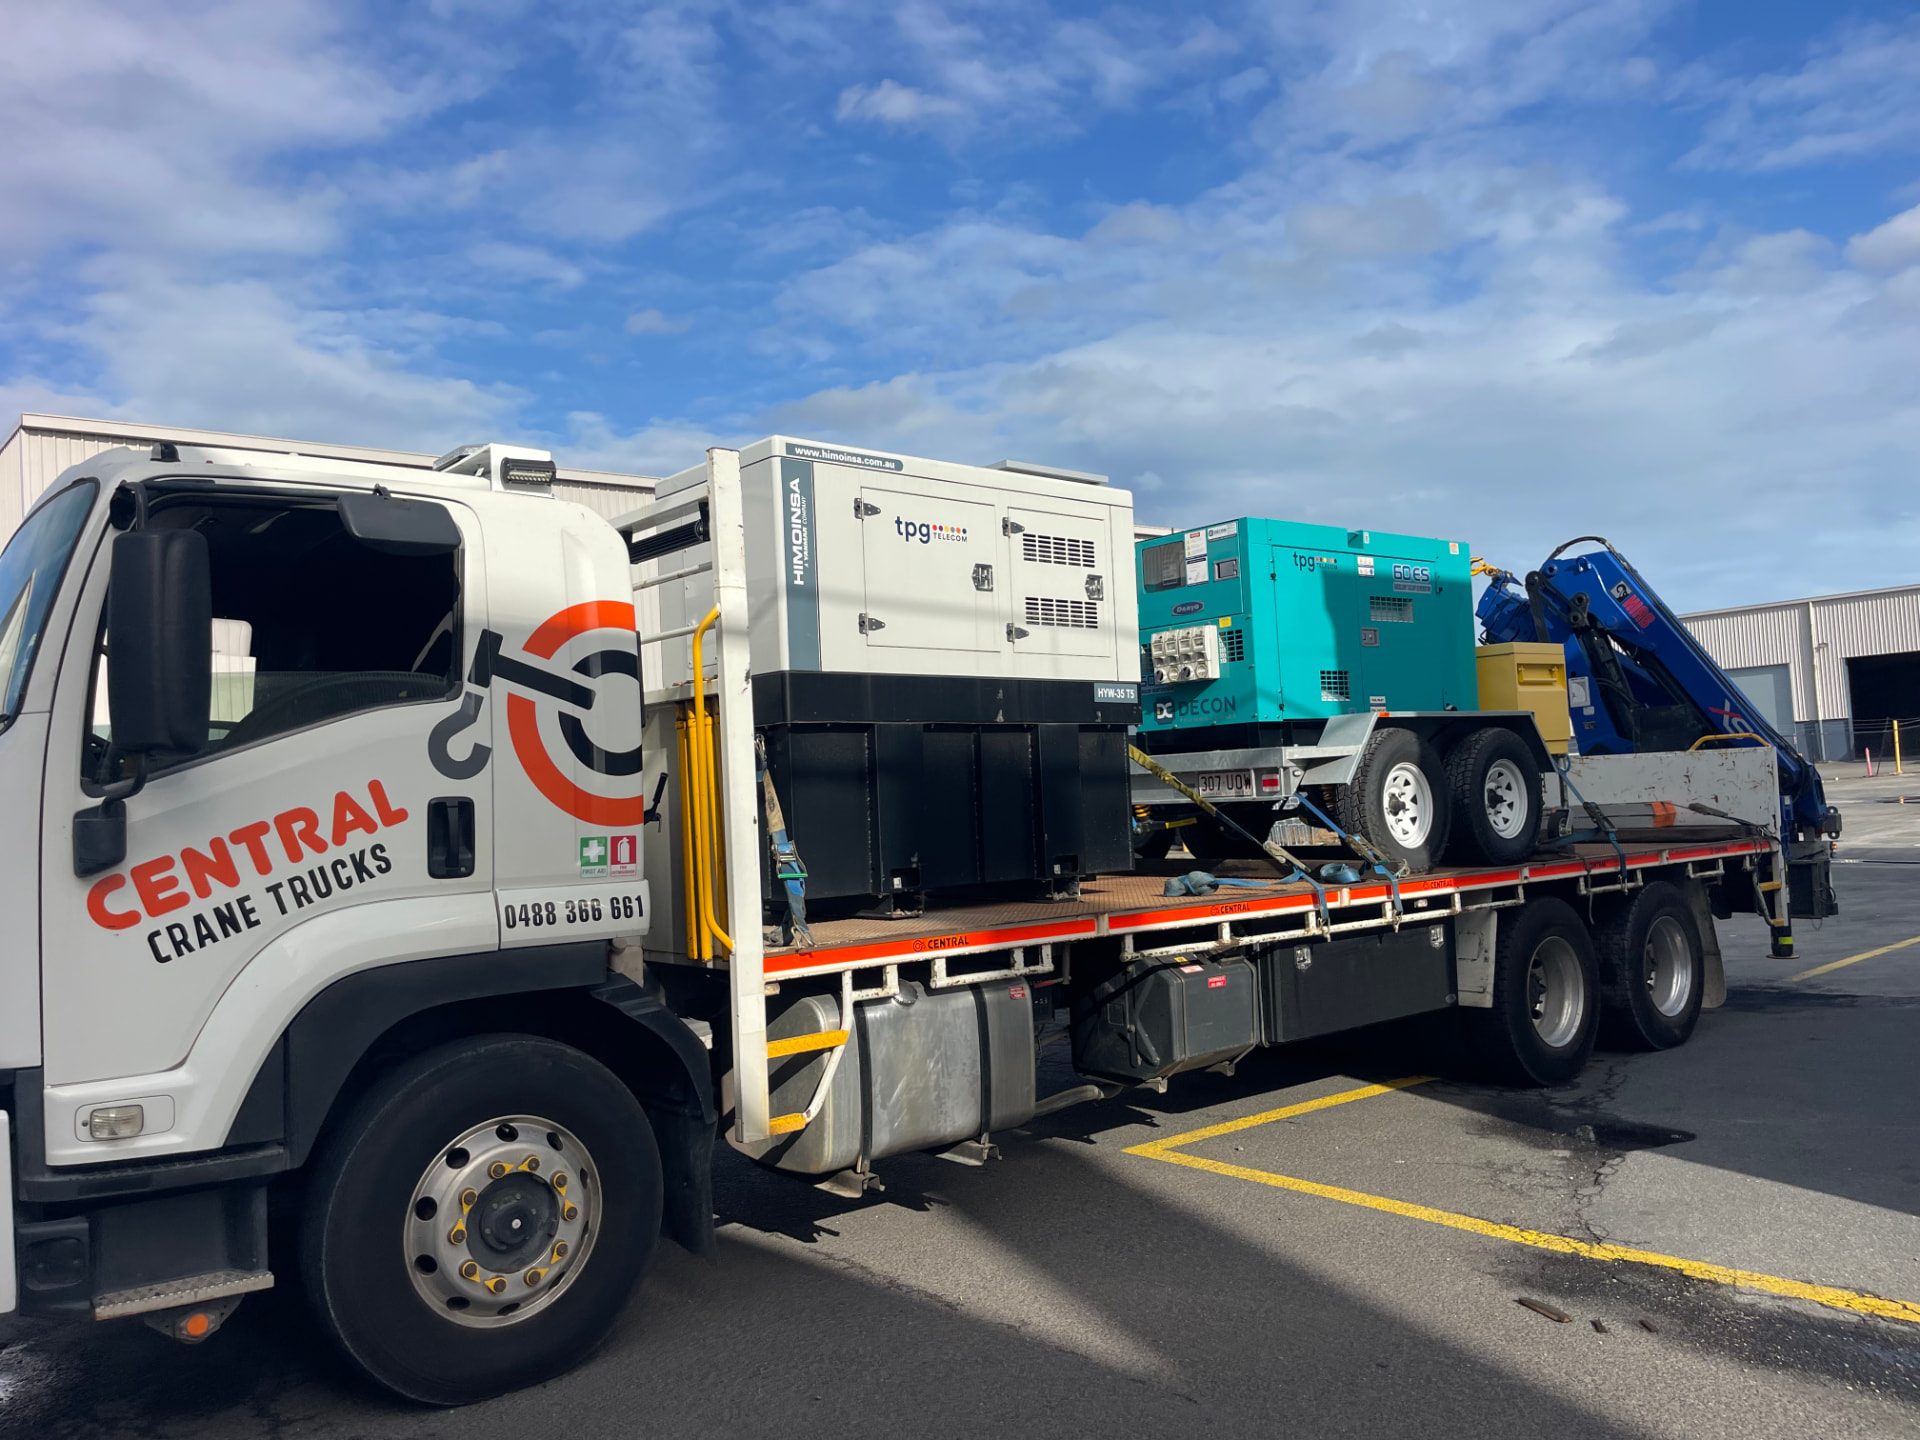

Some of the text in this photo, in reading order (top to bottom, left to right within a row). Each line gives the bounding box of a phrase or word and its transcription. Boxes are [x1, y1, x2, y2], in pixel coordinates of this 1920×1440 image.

[795, 447, 895, 469] www.himoinsa.com.au
[789, 478, 804, 585] HIMOINSA
[895, 515, 931, 544] tpg
[933, 532, 968, 543] TELECOM
[1293, 551, 1316, 572] tpg
[1622, 594, 1656, 628] HIAB
[1097, 688, 1125, 699] HYW-35
[1126, 689, 1135, 699] T5
[1179, 696, 1236, 717] DECON
[1200, 775, 1221, 792] 307
[87, 779, 409, 930] CENTRAL
[1430, 879, 1453, 889] CENTRAL
[147, 843, 392, 964] CRANE TRUCKS
[504, 895, 644, 929] 0488 366 661
[1220, 903, 1250, 914] CENTRAL
[927, 936, 969, 950] CENTRAL
